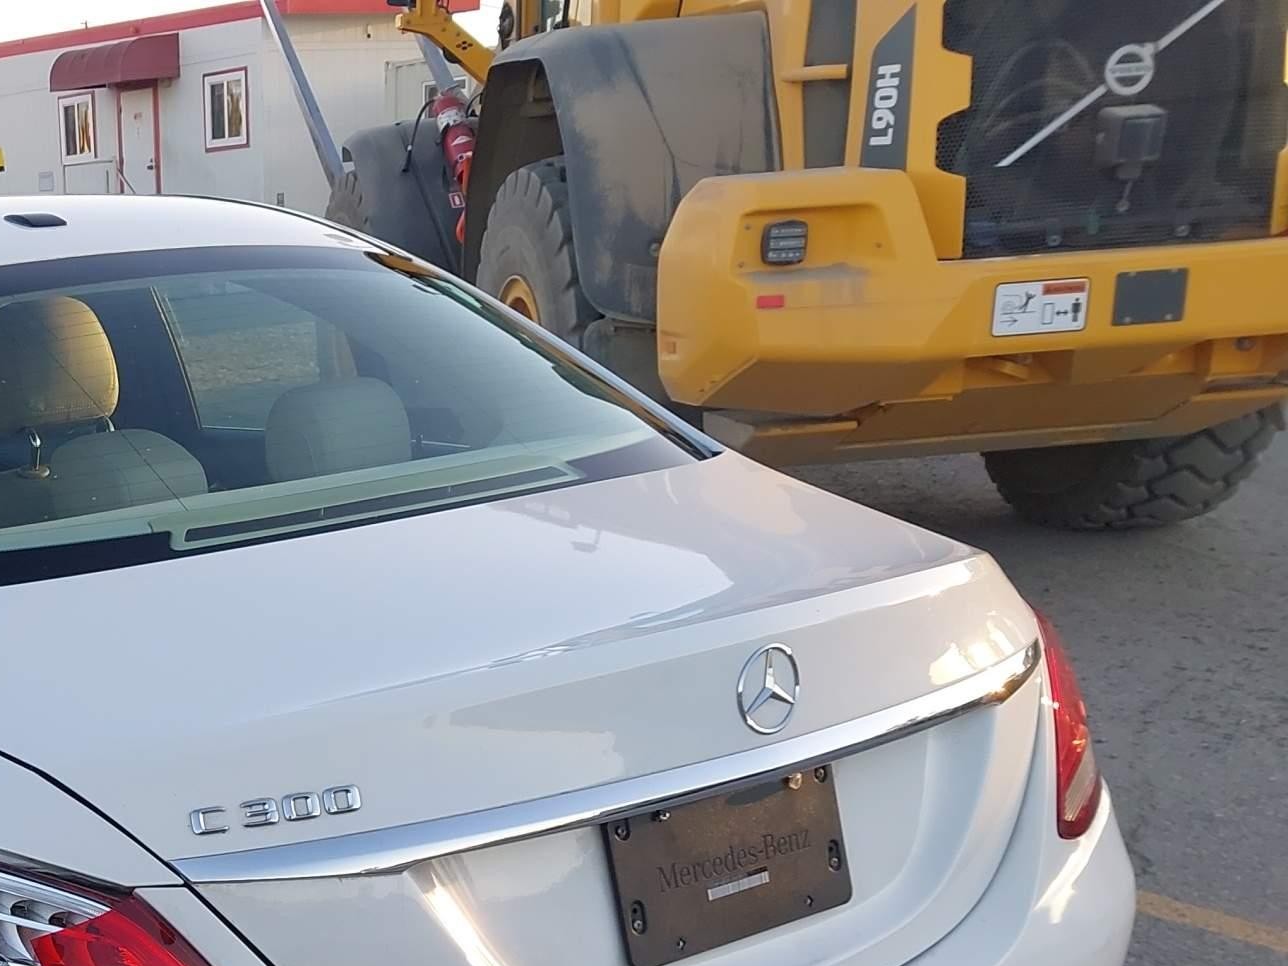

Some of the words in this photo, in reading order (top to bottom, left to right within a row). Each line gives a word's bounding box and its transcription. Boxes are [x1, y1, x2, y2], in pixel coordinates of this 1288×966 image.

[869, 63, 902, 146] L90H
[189, 805, 230, 836] C
[239, 783, 362, 828] 300
[657, 829, 812, 893] Mercedes-Benz
